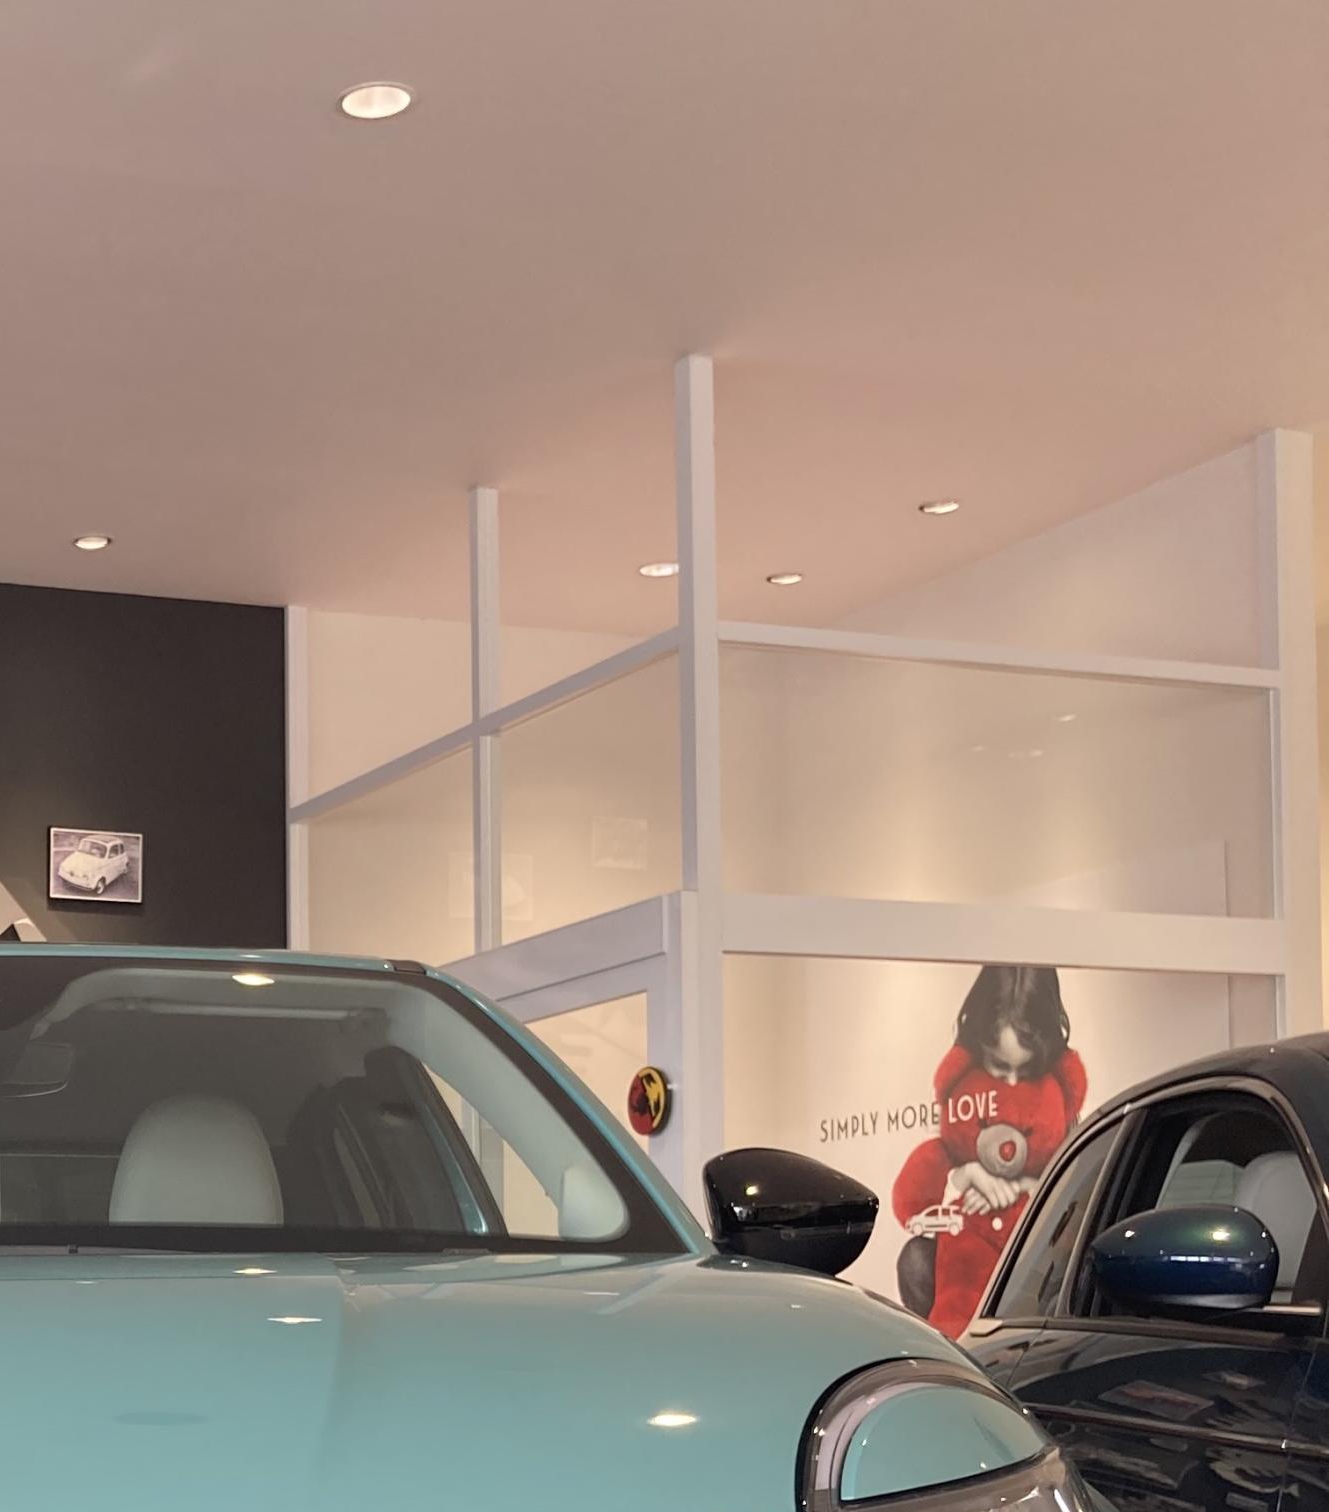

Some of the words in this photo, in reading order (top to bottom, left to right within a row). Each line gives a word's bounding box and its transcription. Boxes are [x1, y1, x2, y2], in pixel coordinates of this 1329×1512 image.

[820, 1110, 879, 1143] SIMPLY
[887, 1101, 940, 1133] MORE
[948, 1089, 999, 1124] LOVE
